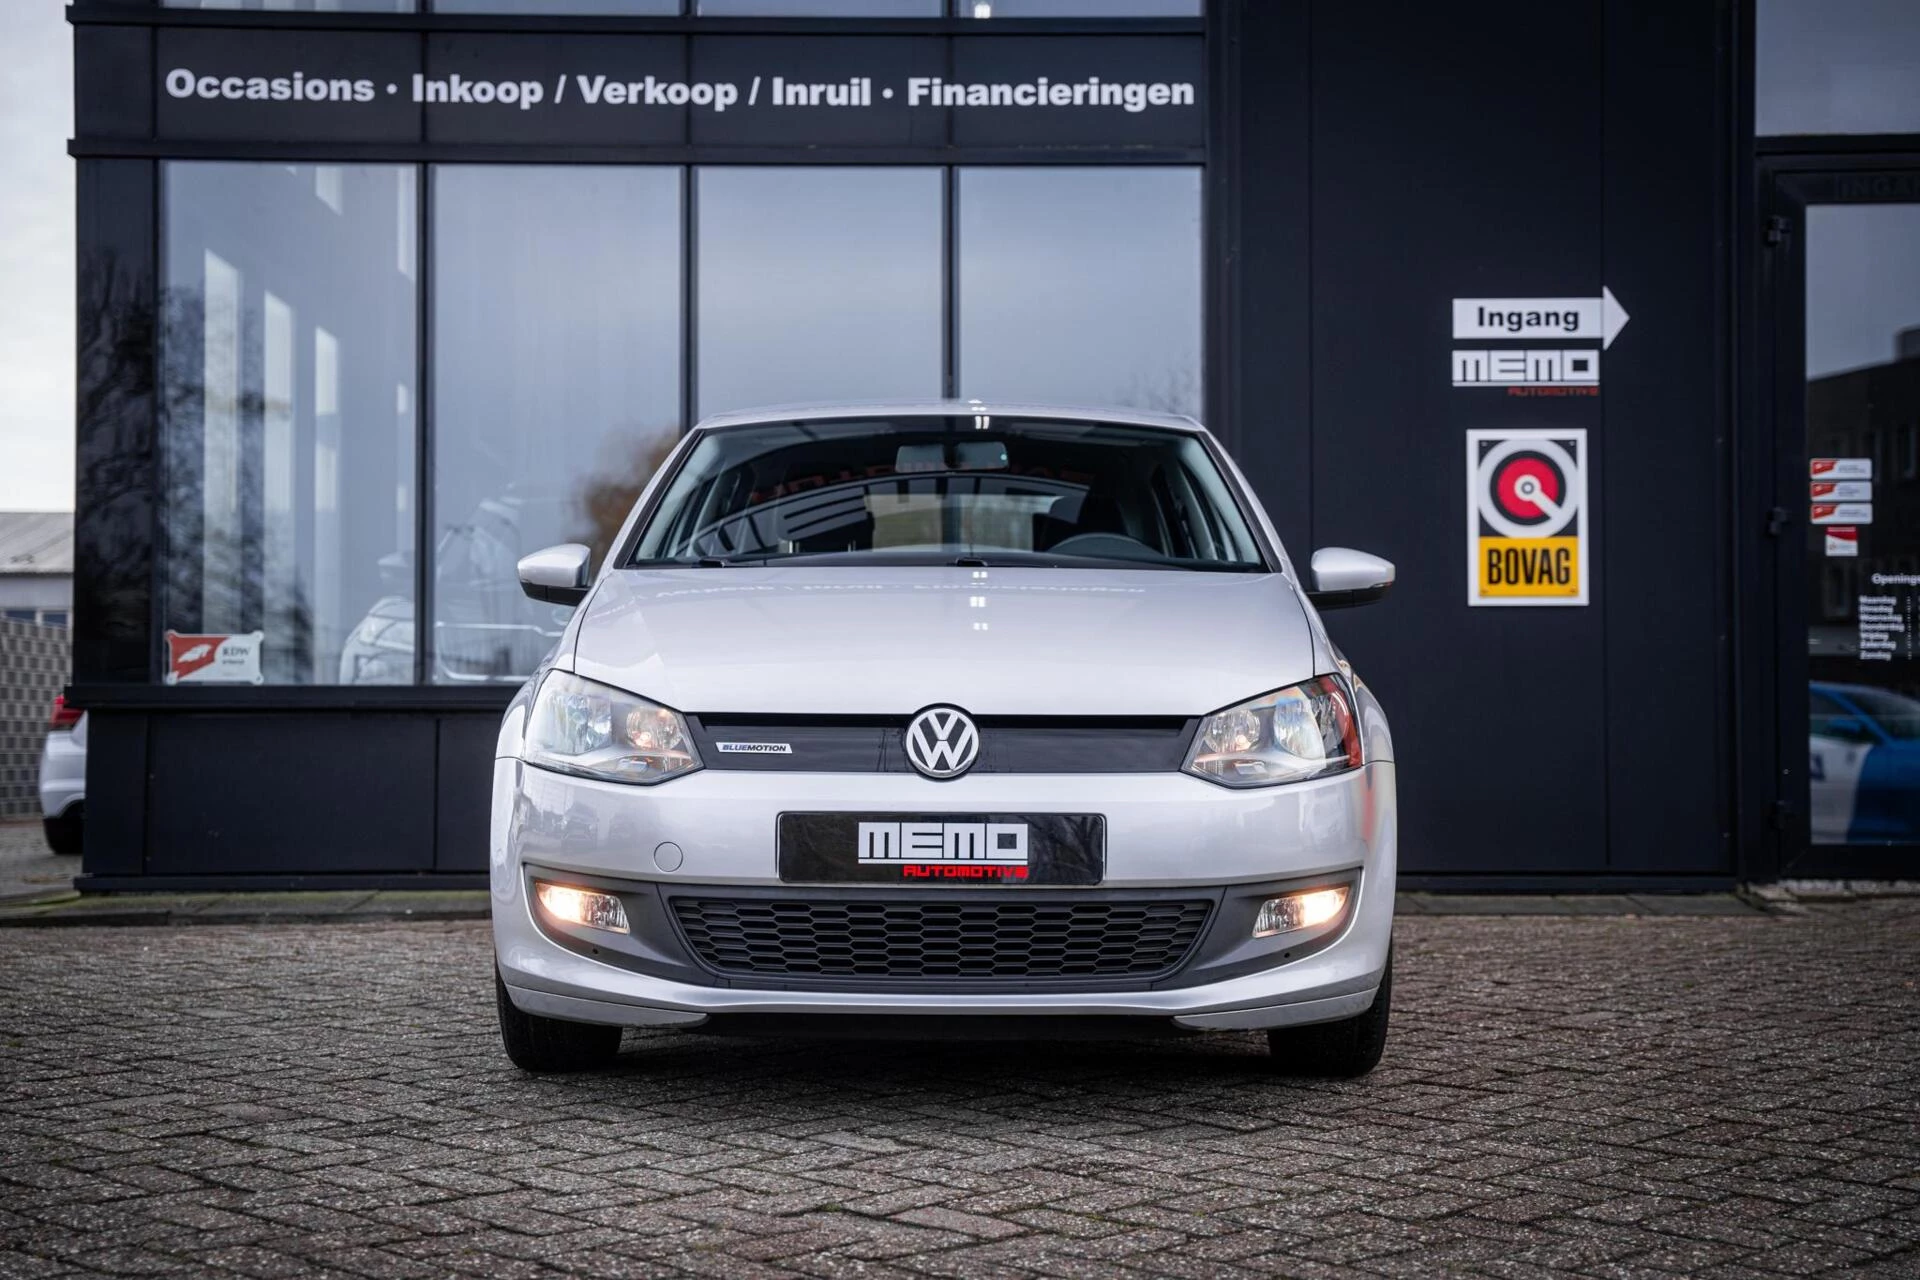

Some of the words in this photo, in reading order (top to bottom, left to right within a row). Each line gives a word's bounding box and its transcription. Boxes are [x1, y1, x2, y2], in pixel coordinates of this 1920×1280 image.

[166, 69, 374, 101] Occasions
[413, 74, 543, 109] Inkoop
[577, 75, 738, 111] Verkoop
[773, 77, 871, 106] Inruil
[908, 77, 1194, 112] Financieringen
[1478, 306, 1579, 332] Ingang
[1452, 350, 1599, 386] MEMO
[1507, 386, 1599, 397] AUTOMOTIVE
[1487, 547, 1570, 586] BOVAG
[722, 743, 787, 752] BLUEMOTION
[858, 822, 1028, 864] MEMO
[903, 864, 1029, 879] AUTOMOTIVE
